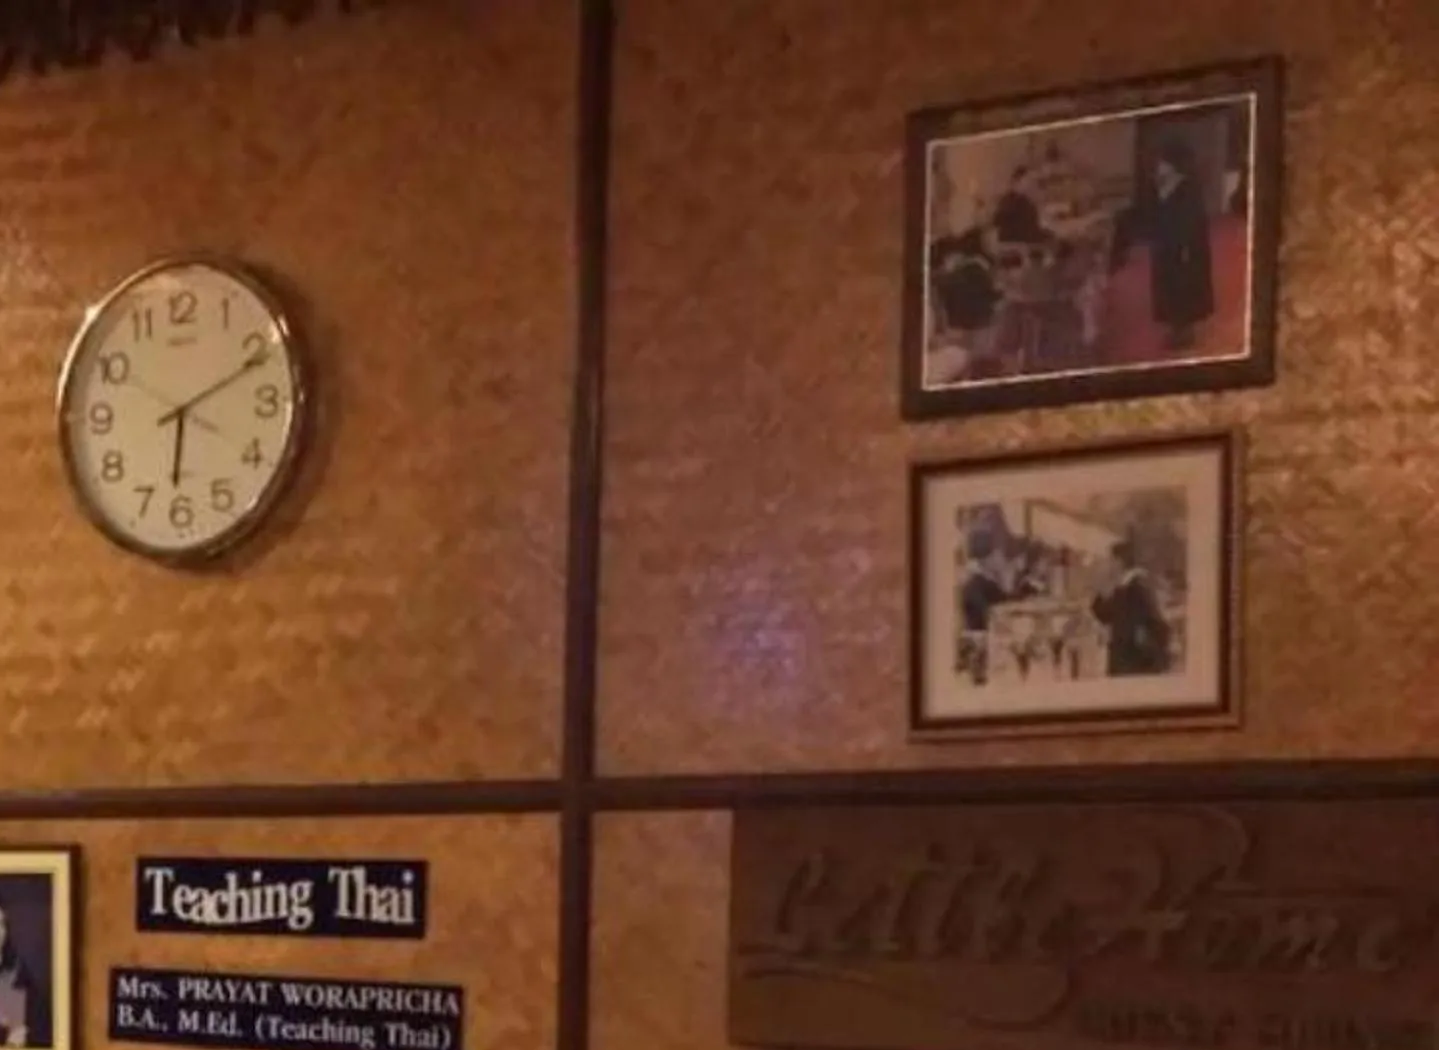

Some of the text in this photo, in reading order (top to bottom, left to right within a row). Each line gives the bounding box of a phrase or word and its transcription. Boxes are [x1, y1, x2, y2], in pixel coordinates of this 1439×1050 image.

[131, 307, 153, 343] 11
[169, 291, 198, 325] 12
[220, 297, 230, 330] 1
[242, 332, 270, 367] 2
[98, 351, 130, 386] 10
[254, 383, 279, 418] 3
[89, 403, 114, 436] 9
[100, 450, 124, 483] 8
[240, 438, 264, 469] 4
[133, 485, 156, 518] 7
[168, 495, 195, 529] 6
[210, 478, 235, 512] 5
[143, 866, 415, 930] Teaching Thai
[117, 976, 461, 1016] Mrs. PRAYAT WORAPRICHA
[177, 1009, 244, 1038] M.Ed.
[254, 1015, 377, 1050] (Teaching
